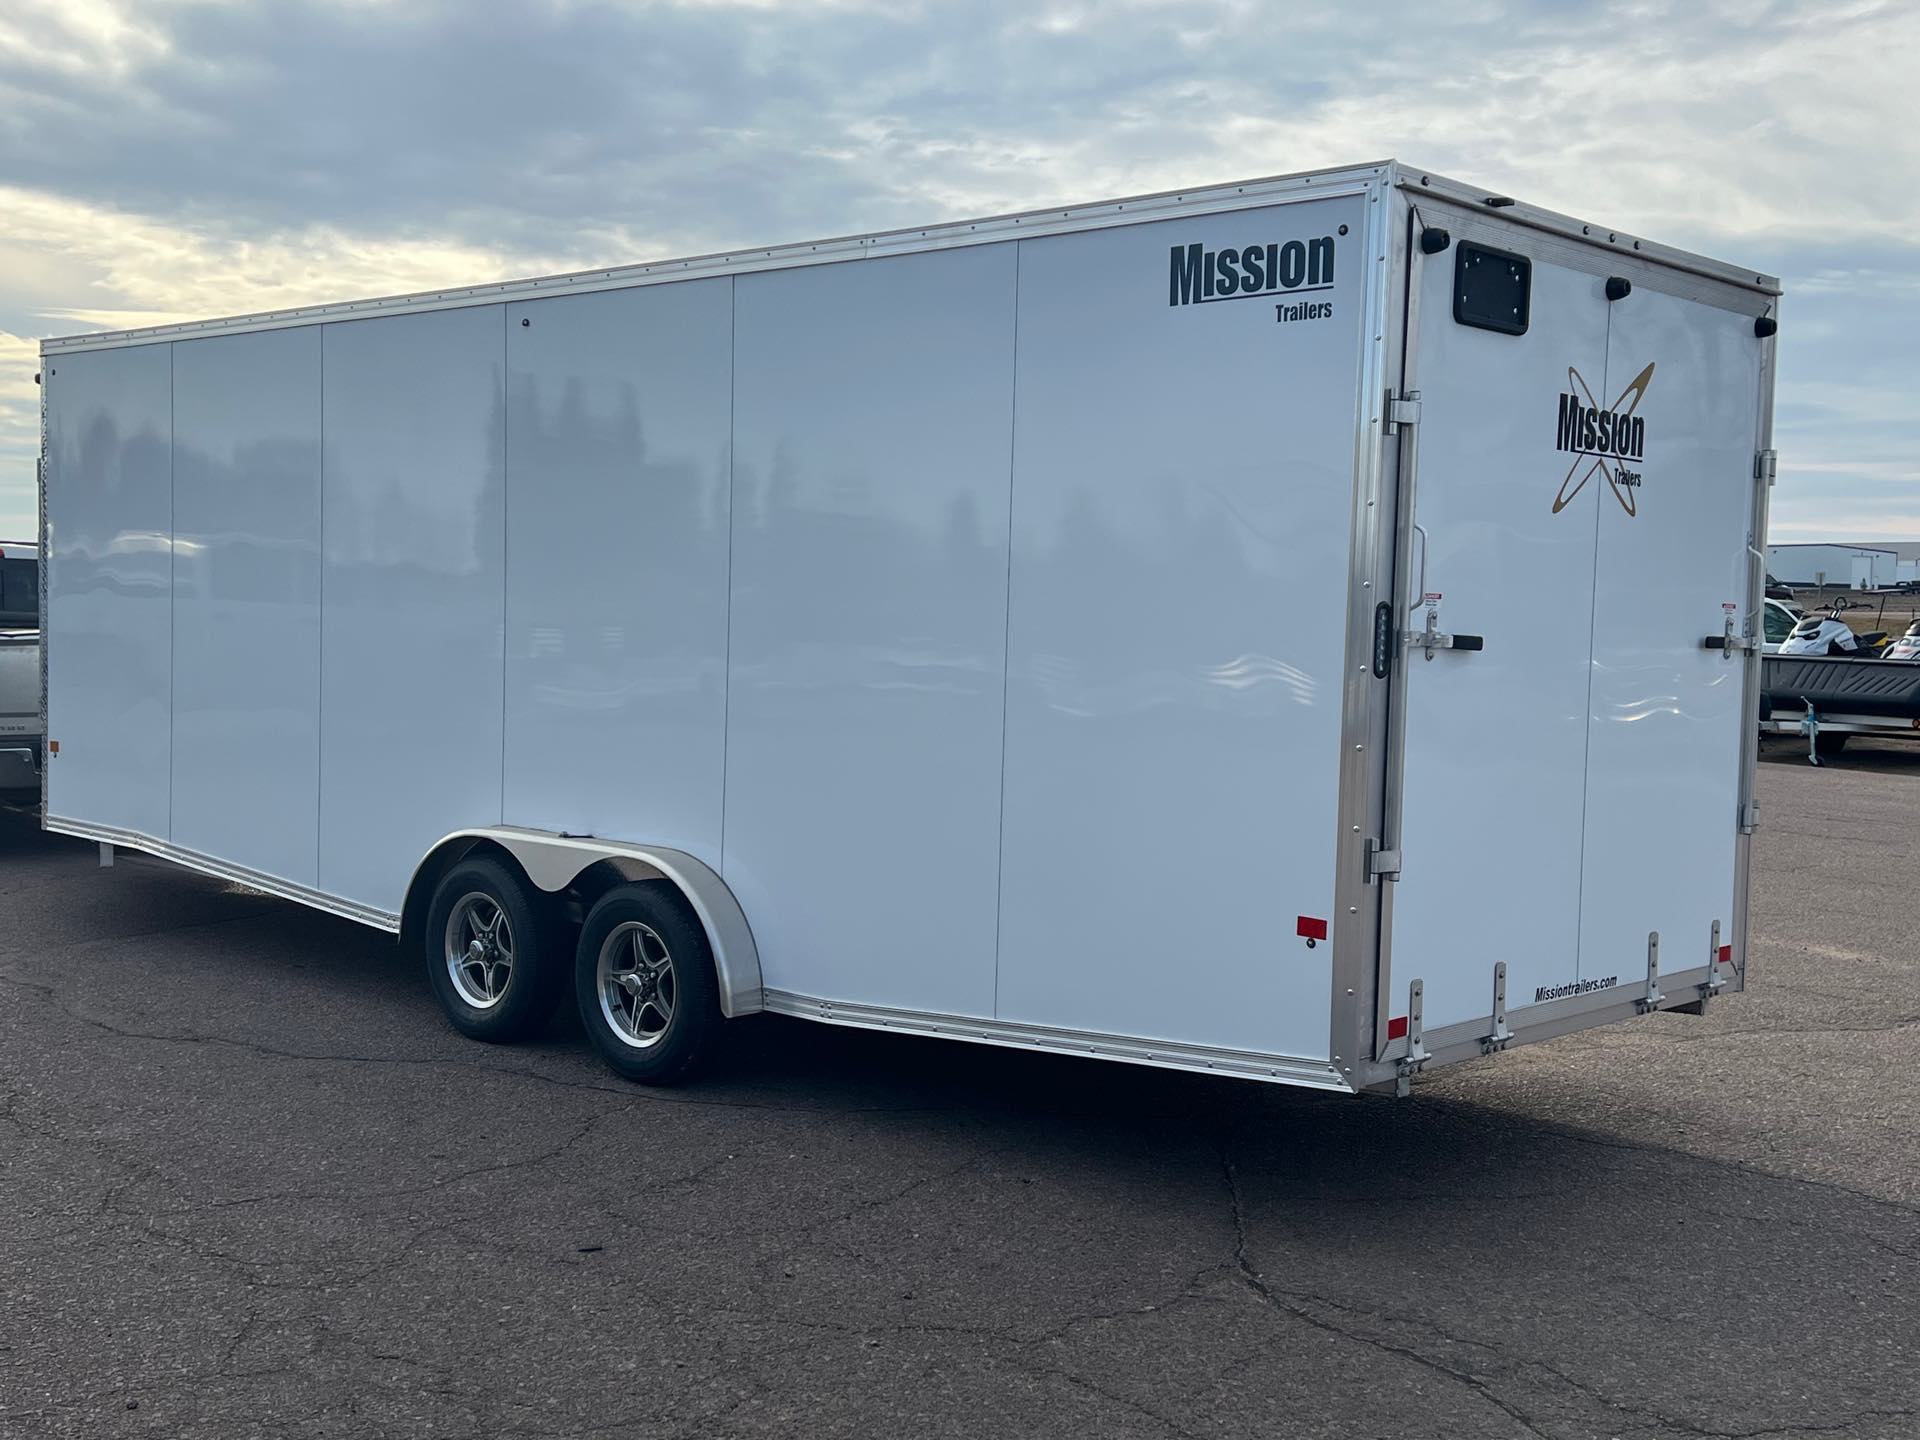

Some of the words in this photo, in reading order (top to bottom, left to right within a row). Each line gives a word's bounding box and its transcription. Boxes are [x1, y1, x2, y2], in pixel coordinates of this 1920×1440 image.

[1169, 236, 1335, 306] Mission
[1275, 302, 1332, 323] Trailers
[1557, 393, 1645, 459] Mission
[1614, 468, 1642, 488] Trailers
[1535, 976, 1617, 1002] Missiontrailers.com
